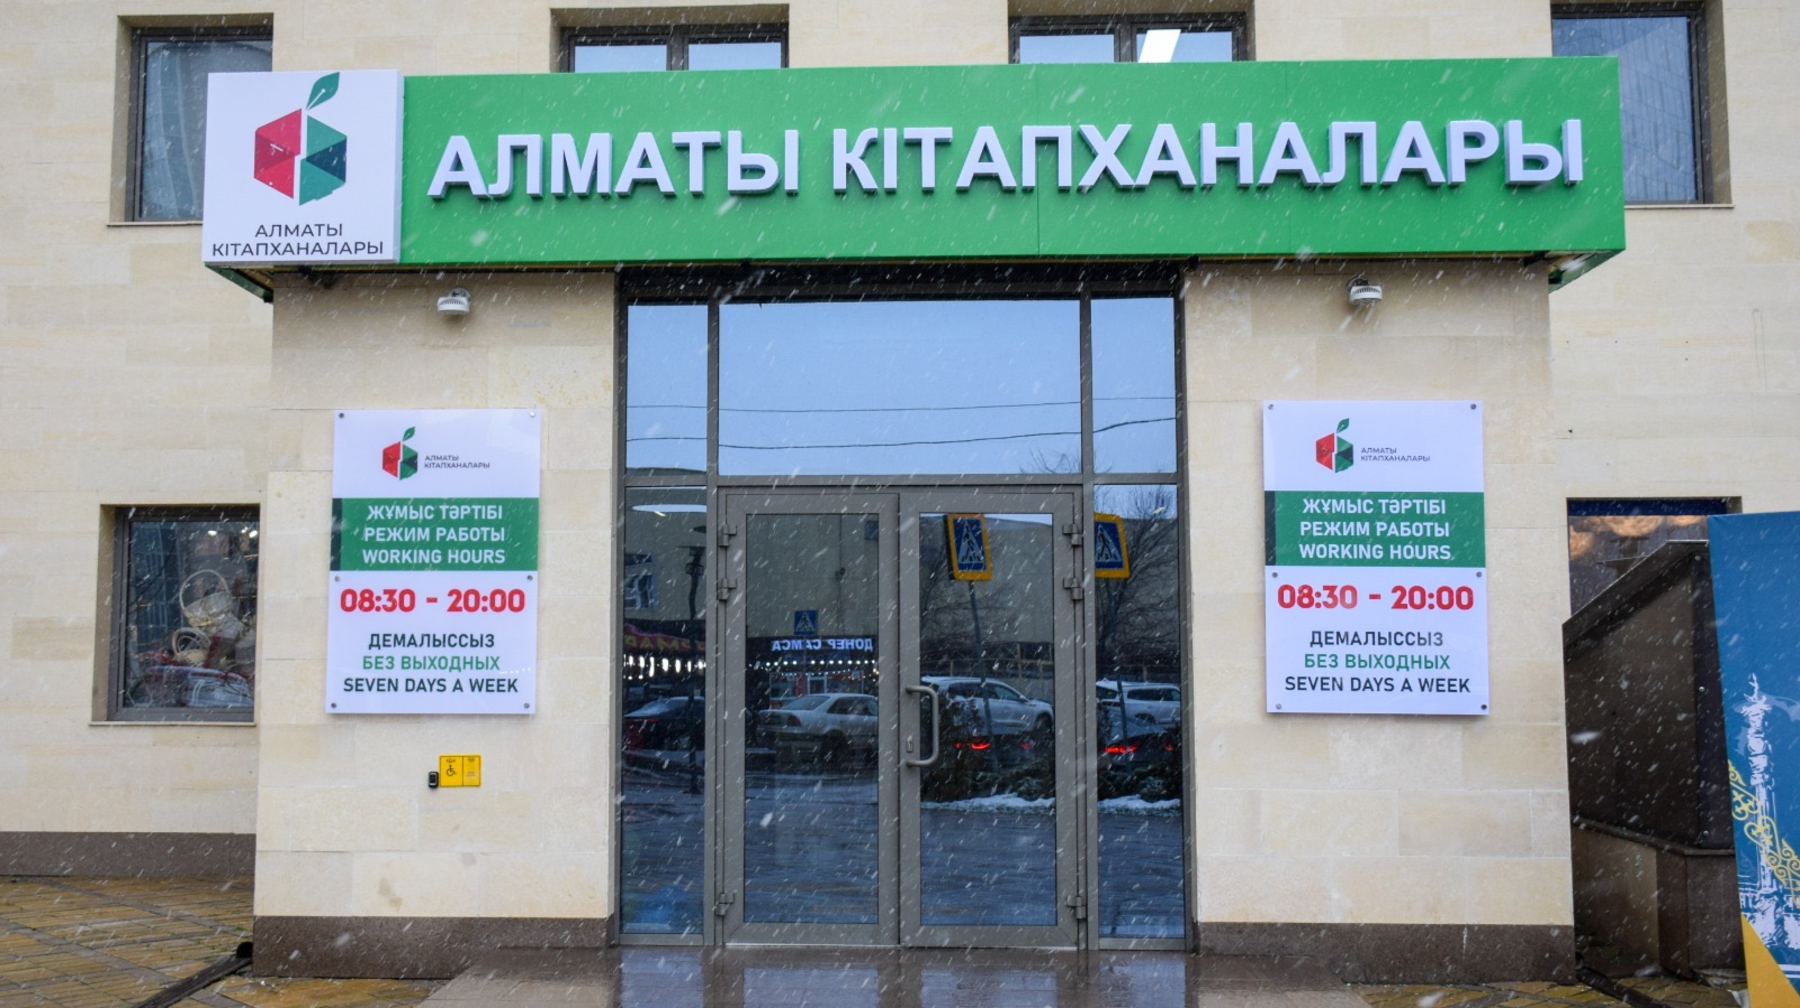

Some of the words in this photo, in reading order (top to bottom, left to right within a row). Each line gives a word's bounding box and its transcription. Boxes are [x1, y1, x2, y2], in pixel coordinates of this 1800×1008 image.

[428, 128, 799, 199] АЛМАТЫ
[833, 119, 1584, 192] КІТАПХАНАЛАРЫ
[255, 223, 343, 237] АЛМАТЫ
[212, 241, 383, 256] КІТАПХАНАЛАРЫ
[367, 505, 435, 520] ЖҰМЫС
[440, 505, 503, 520] ТӘРТІБІ
[1303, 499, 1373, 514] ЖҰМЫС
[1378, 499, 1446, 514] ТӘРТІБІ
[364, 527, 430, 542] РЕЖИМ
[436, 527, 505, 542] РАБОТЫ
[1301, 521, 1370, 536] РЕЖИМ
[1376, 522, 1450, 537] РАБОТЫ
[362, 549, 442, 564] WORKING
[448, 549, 506, 564] HOURS
[1299, 544, 1384, 559] WORKING
[1390, 544, 1451, 560] HOURS
[340, 588, 416, 612] 08:30
[446, 588, 526, 612] 20:00
[1277, 584, 1358, 609] 08:30
[1391, 585, 1474, 610] 20:00
[369, 633, 495, 650] ДЕМАЛЫССЫЗ
[1310, 630, 1443, 647] ДЕМАЛЫССЫЗ
[362, 656, 395, 670] БЕЗ
[401, 656, 500, 672] ВЫХОДНЫХ
[1304, 653, 1339, 669] БЕЗ
[1345, 654, 1450, 671] ВЫХОДНЫХ
[343, 678, 398, 692] SEVEN
[405, 678, 447, 692] DAYS
[452, 678, 464, 692] A
[469, 678, 518, 692] WEEK
[1285, 676, 1343, 691] SEVEN
[1350, 677, 1395, 692] DAYS
[1401, 678, 1413, 692] A
[1418, 678, 1471, 693] WEEK
